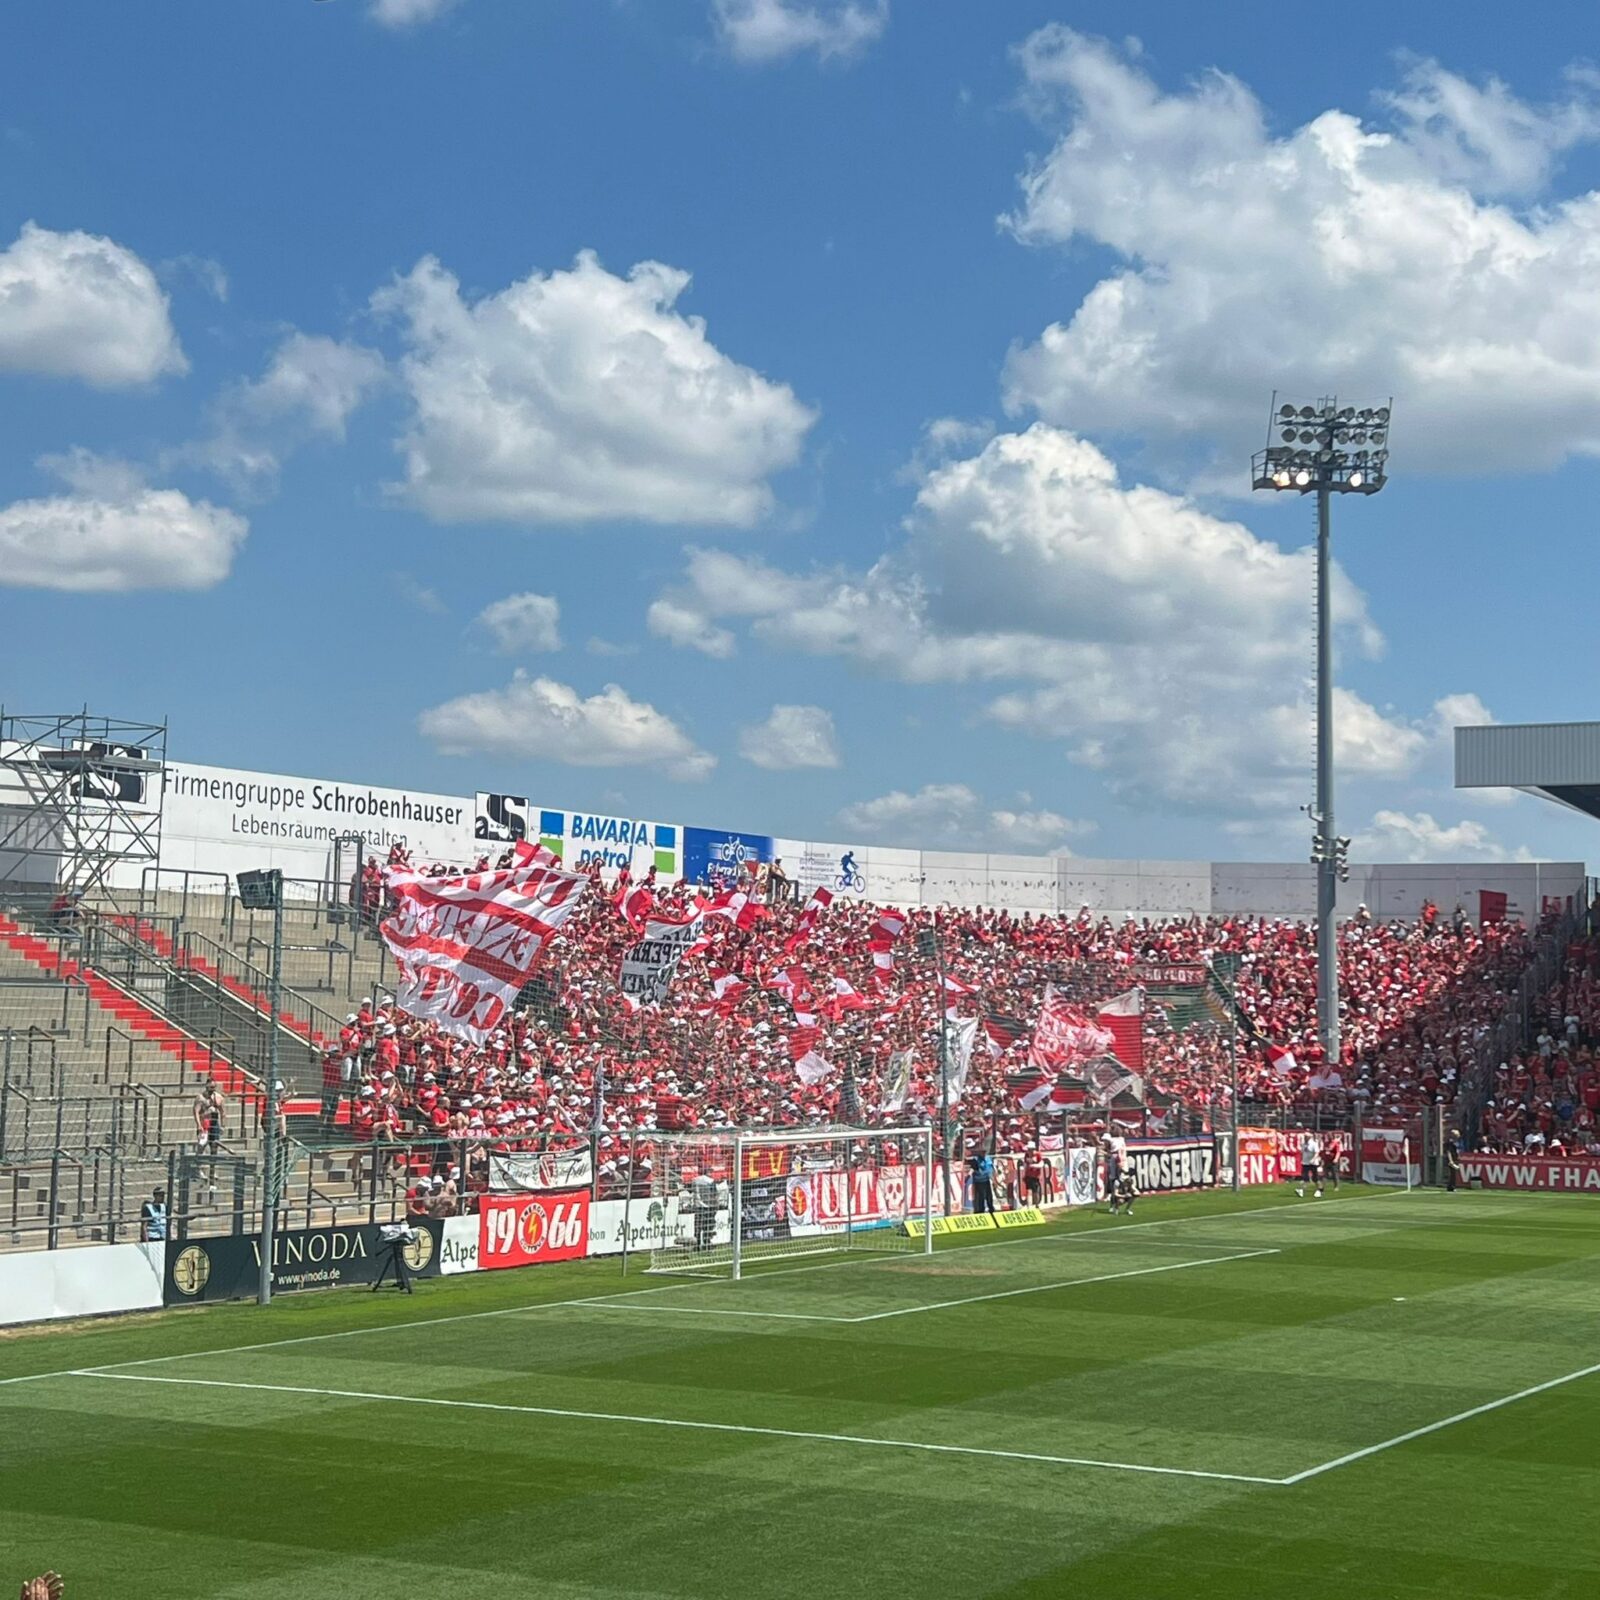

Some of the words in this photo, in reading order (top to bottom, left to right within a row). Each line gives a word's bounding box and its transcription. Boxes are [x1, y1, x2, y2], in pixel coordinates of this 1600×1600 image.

[164, 768, 305, 811] Firmengruppe
[312, 785, 463, 825] Schrobenhauser
[232, 813, 337, 841] Lebensräume
[571, 814, 648, 846] BAVARIA
[487, 1207, 516, 1254] 19
[548, 1202, 582, 1249] 66
[614, 1219, 686, 1247] Alpenbauer
[251, 1231, 368, 1268] VINODA
[277, 1268, 341, 1286] www.vinoda.de
